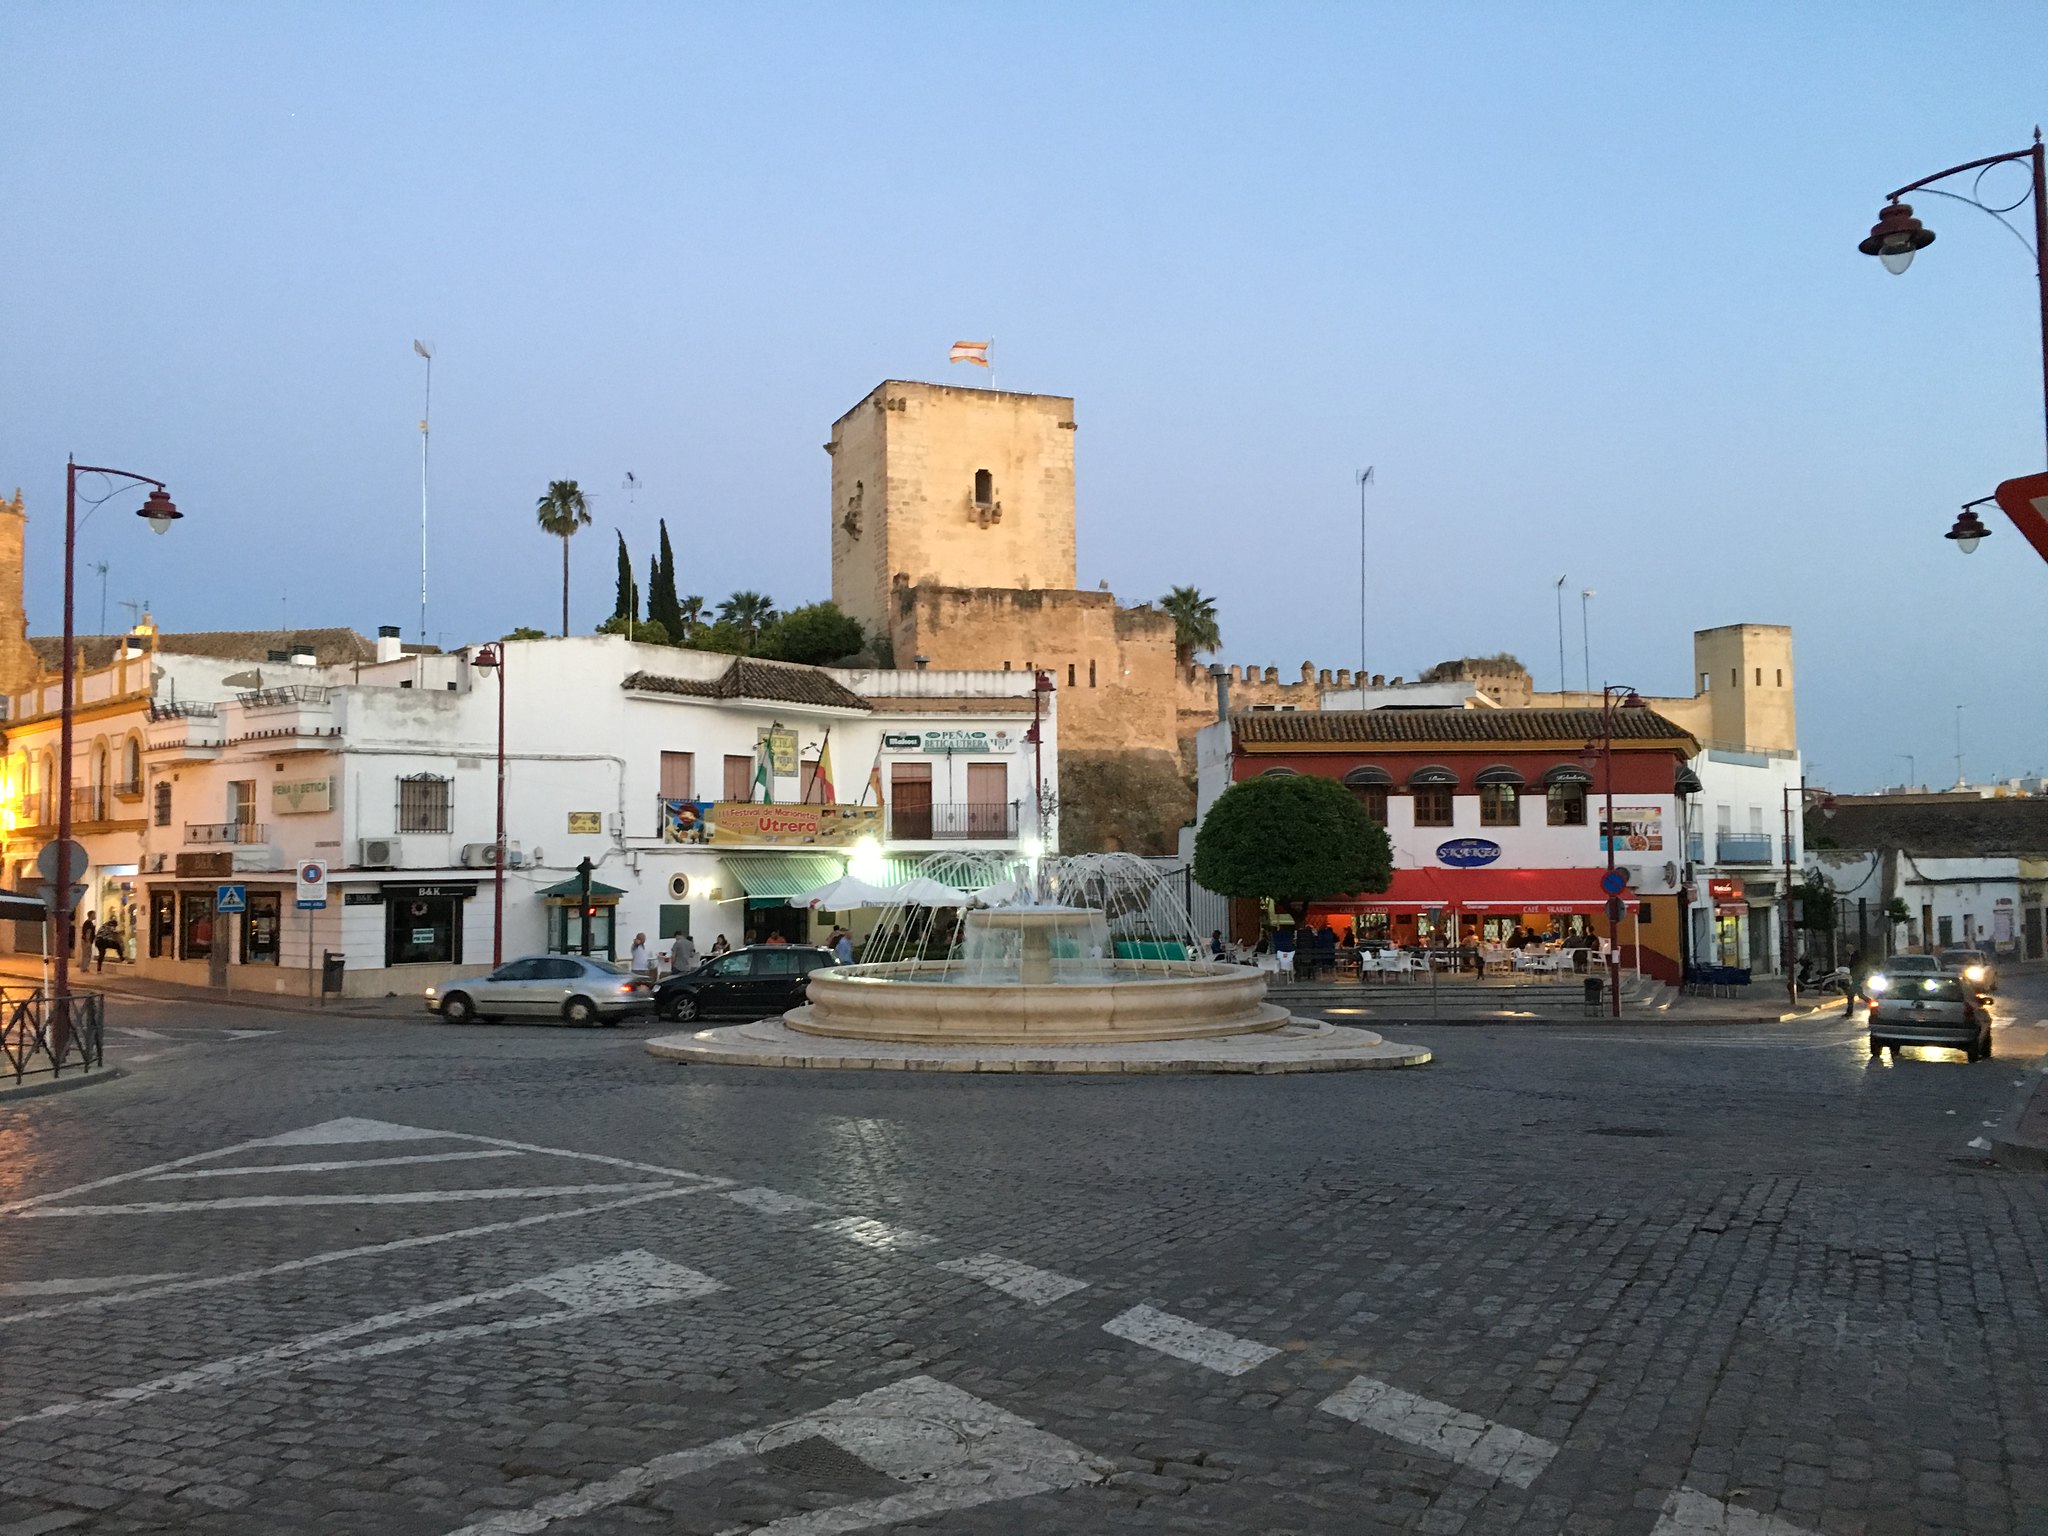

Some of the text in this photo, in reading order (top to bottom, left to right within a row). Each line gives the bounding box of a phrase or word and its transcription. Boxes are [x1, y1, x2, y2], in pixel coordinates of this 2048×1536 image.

[942, 730, 971, 739] PEÑA
[924, 739, 989, 748] BETICA UTRERA
[730, 808, 760, 818] Festival
[763, 808, 773, 816] de
[774, 808, 820, 821] Marionetas
[759, 817, 817, 832] Utrera
[418, 887, 441, 897] B&K
[1522, 904, 1573, 913] CAFÉ SKAKEO
